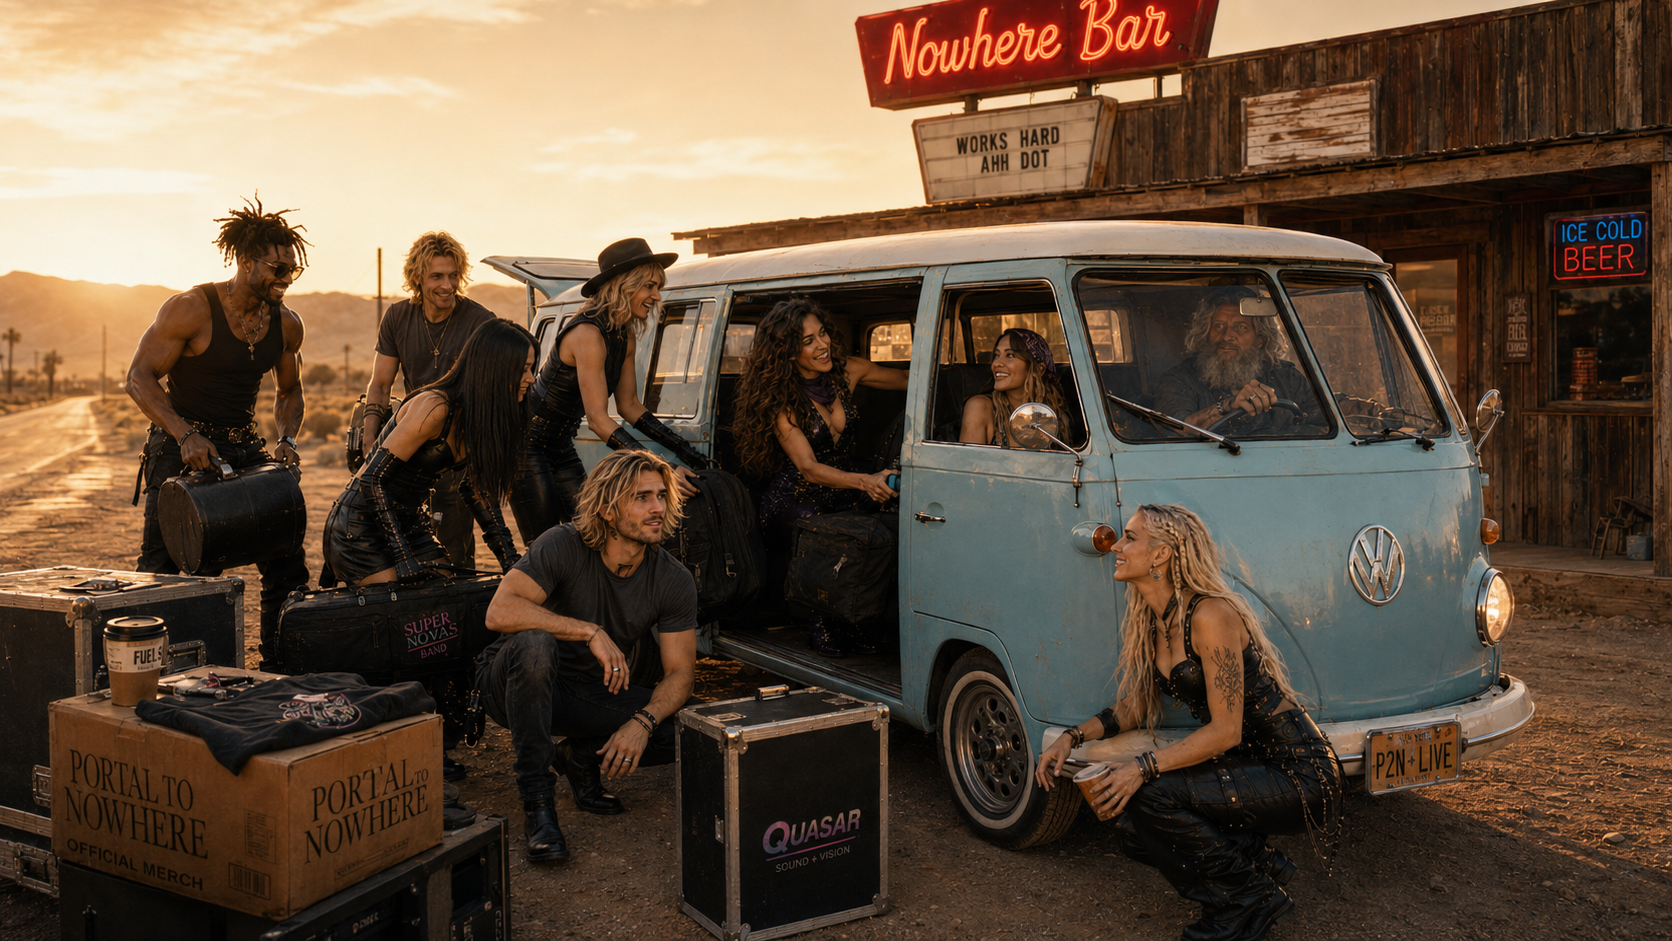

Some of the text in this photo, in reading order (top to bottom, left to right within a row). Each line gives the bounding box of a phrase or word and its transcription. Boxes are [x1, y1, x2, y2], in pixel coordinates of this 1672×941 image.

[884, 0, 1171, 84] Nowhere Bar
[956, 126, 1060, 155] WORKS HARD
[980, 149, 1050, 174] AHH DOT
[1561, 219, 1642, 243] ICE COLD
[1564, 243, 1635, 272] BEER
[1348, 524, 1405, 607] VW
[404, 611, 451, 637] SUPER
[406, 622, 458, 649] NOVAS
[420, 643, 447, 659] BAND
[69, 749, 194, 811] PORTAL TO
[312, 759, 429, 823] PORTAL TO
[64, 786, 208, 859] NOWHERE
[304, 784, 428, 865] NOWHERE
[762, 808, 861, 854] QUASAR
[67, 838, 203, 891] OFFICIAL MERCH
[775, 856, 809, 873] SOUND
[819, 845, 850, 861] VISION
